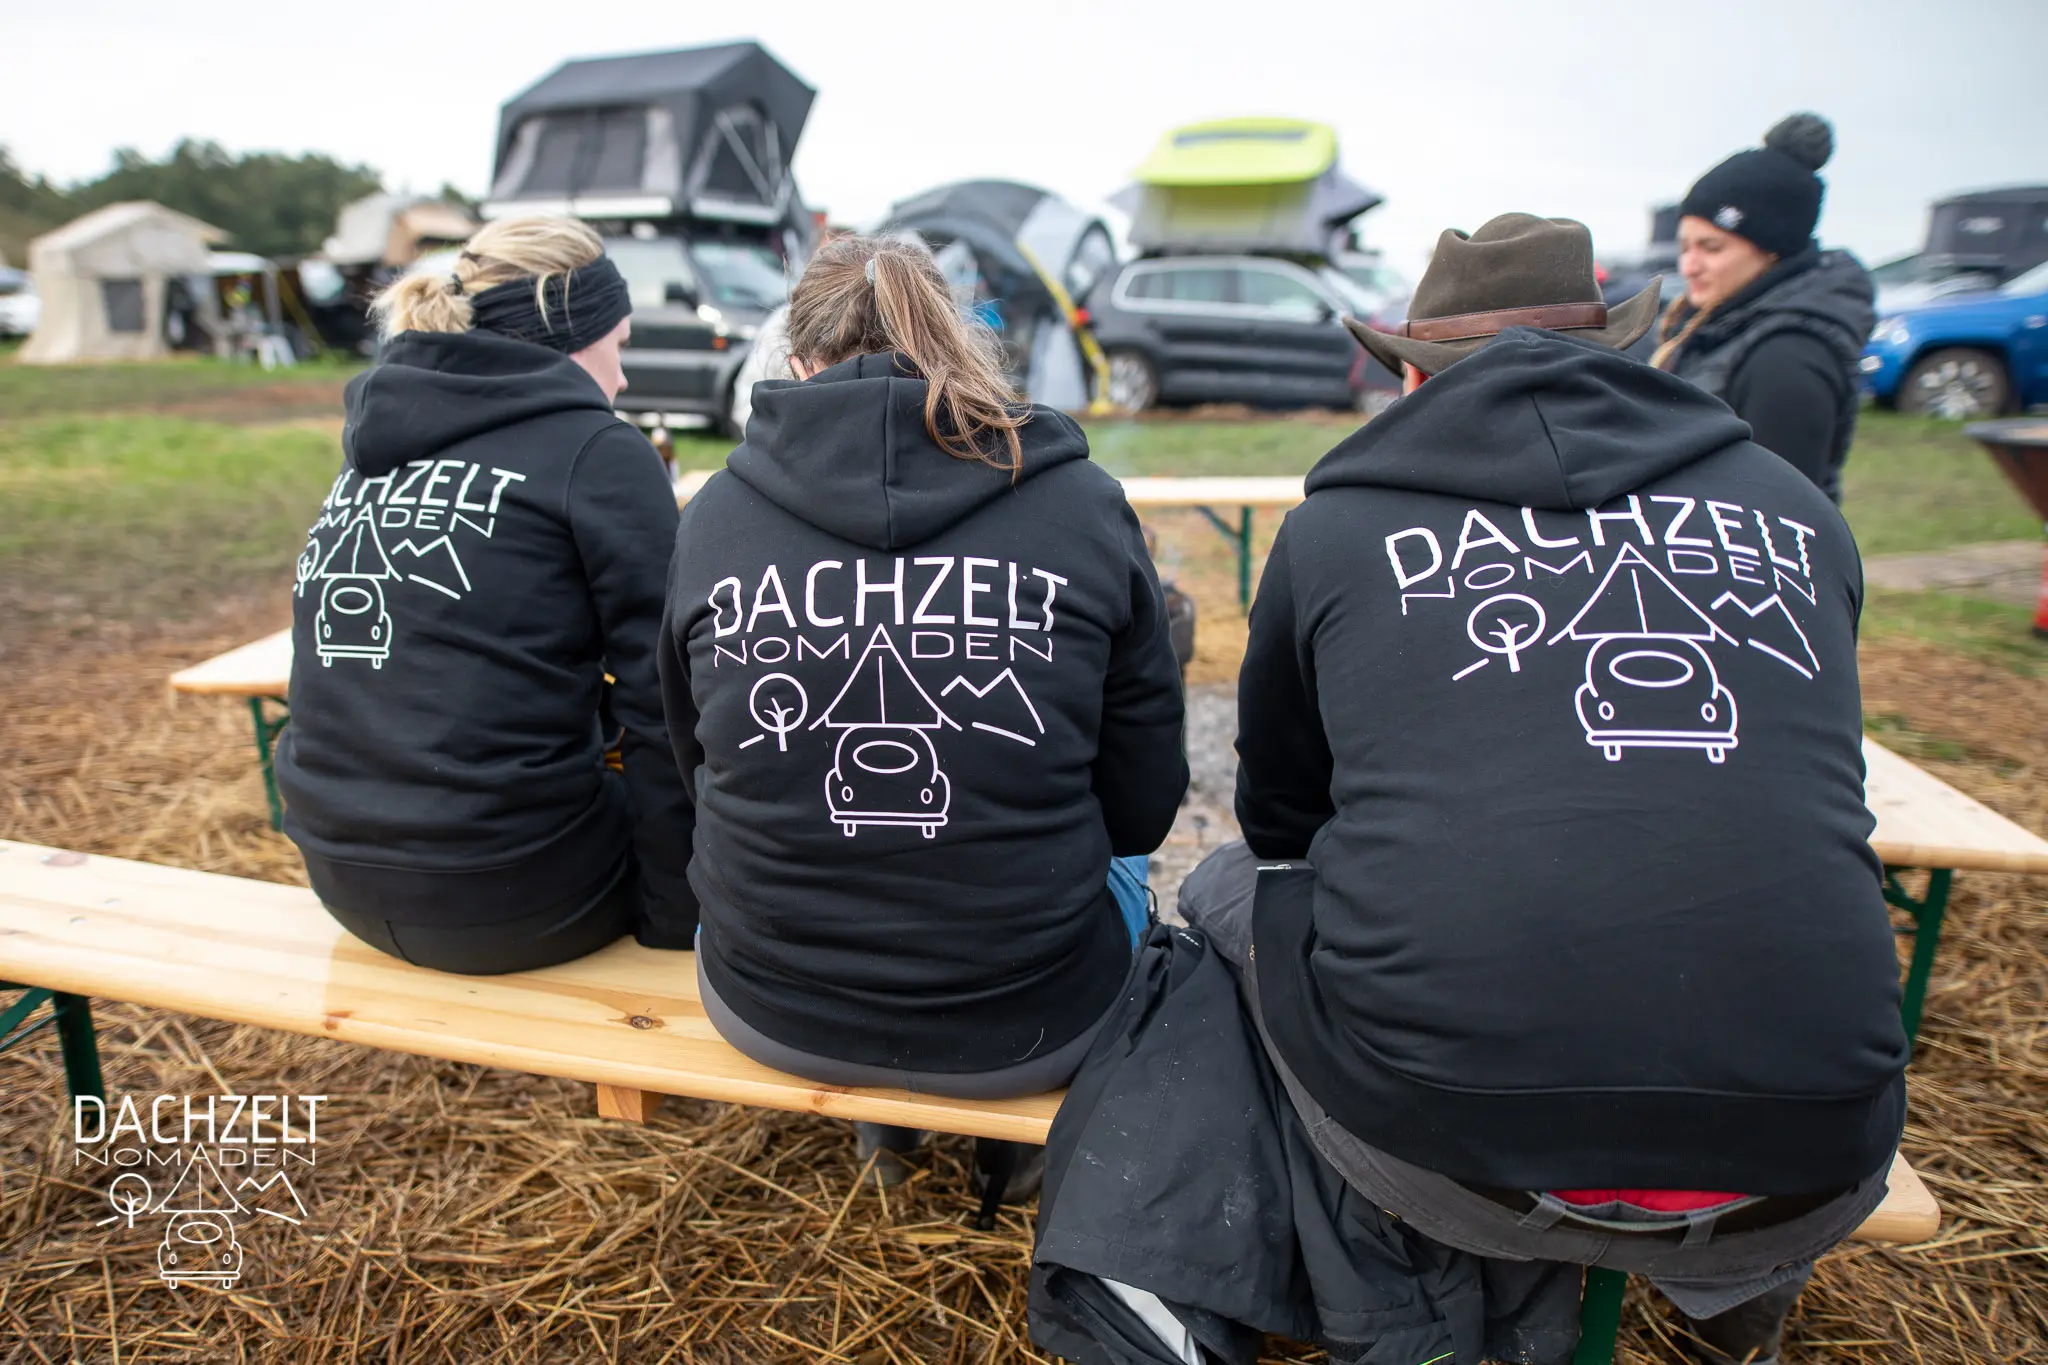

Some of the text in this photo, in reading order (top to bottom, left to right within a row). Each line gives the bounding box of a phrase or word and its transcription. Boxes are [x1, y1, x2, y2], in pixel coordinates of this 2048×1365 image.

[1385, 494, 1816, 589] DACHZELT
[1402, 542, 1816, 615] NOMADEN
[708, 556, 1068, 638] DACHZELT
[714, 623, 1053, 667] NOMADEN
